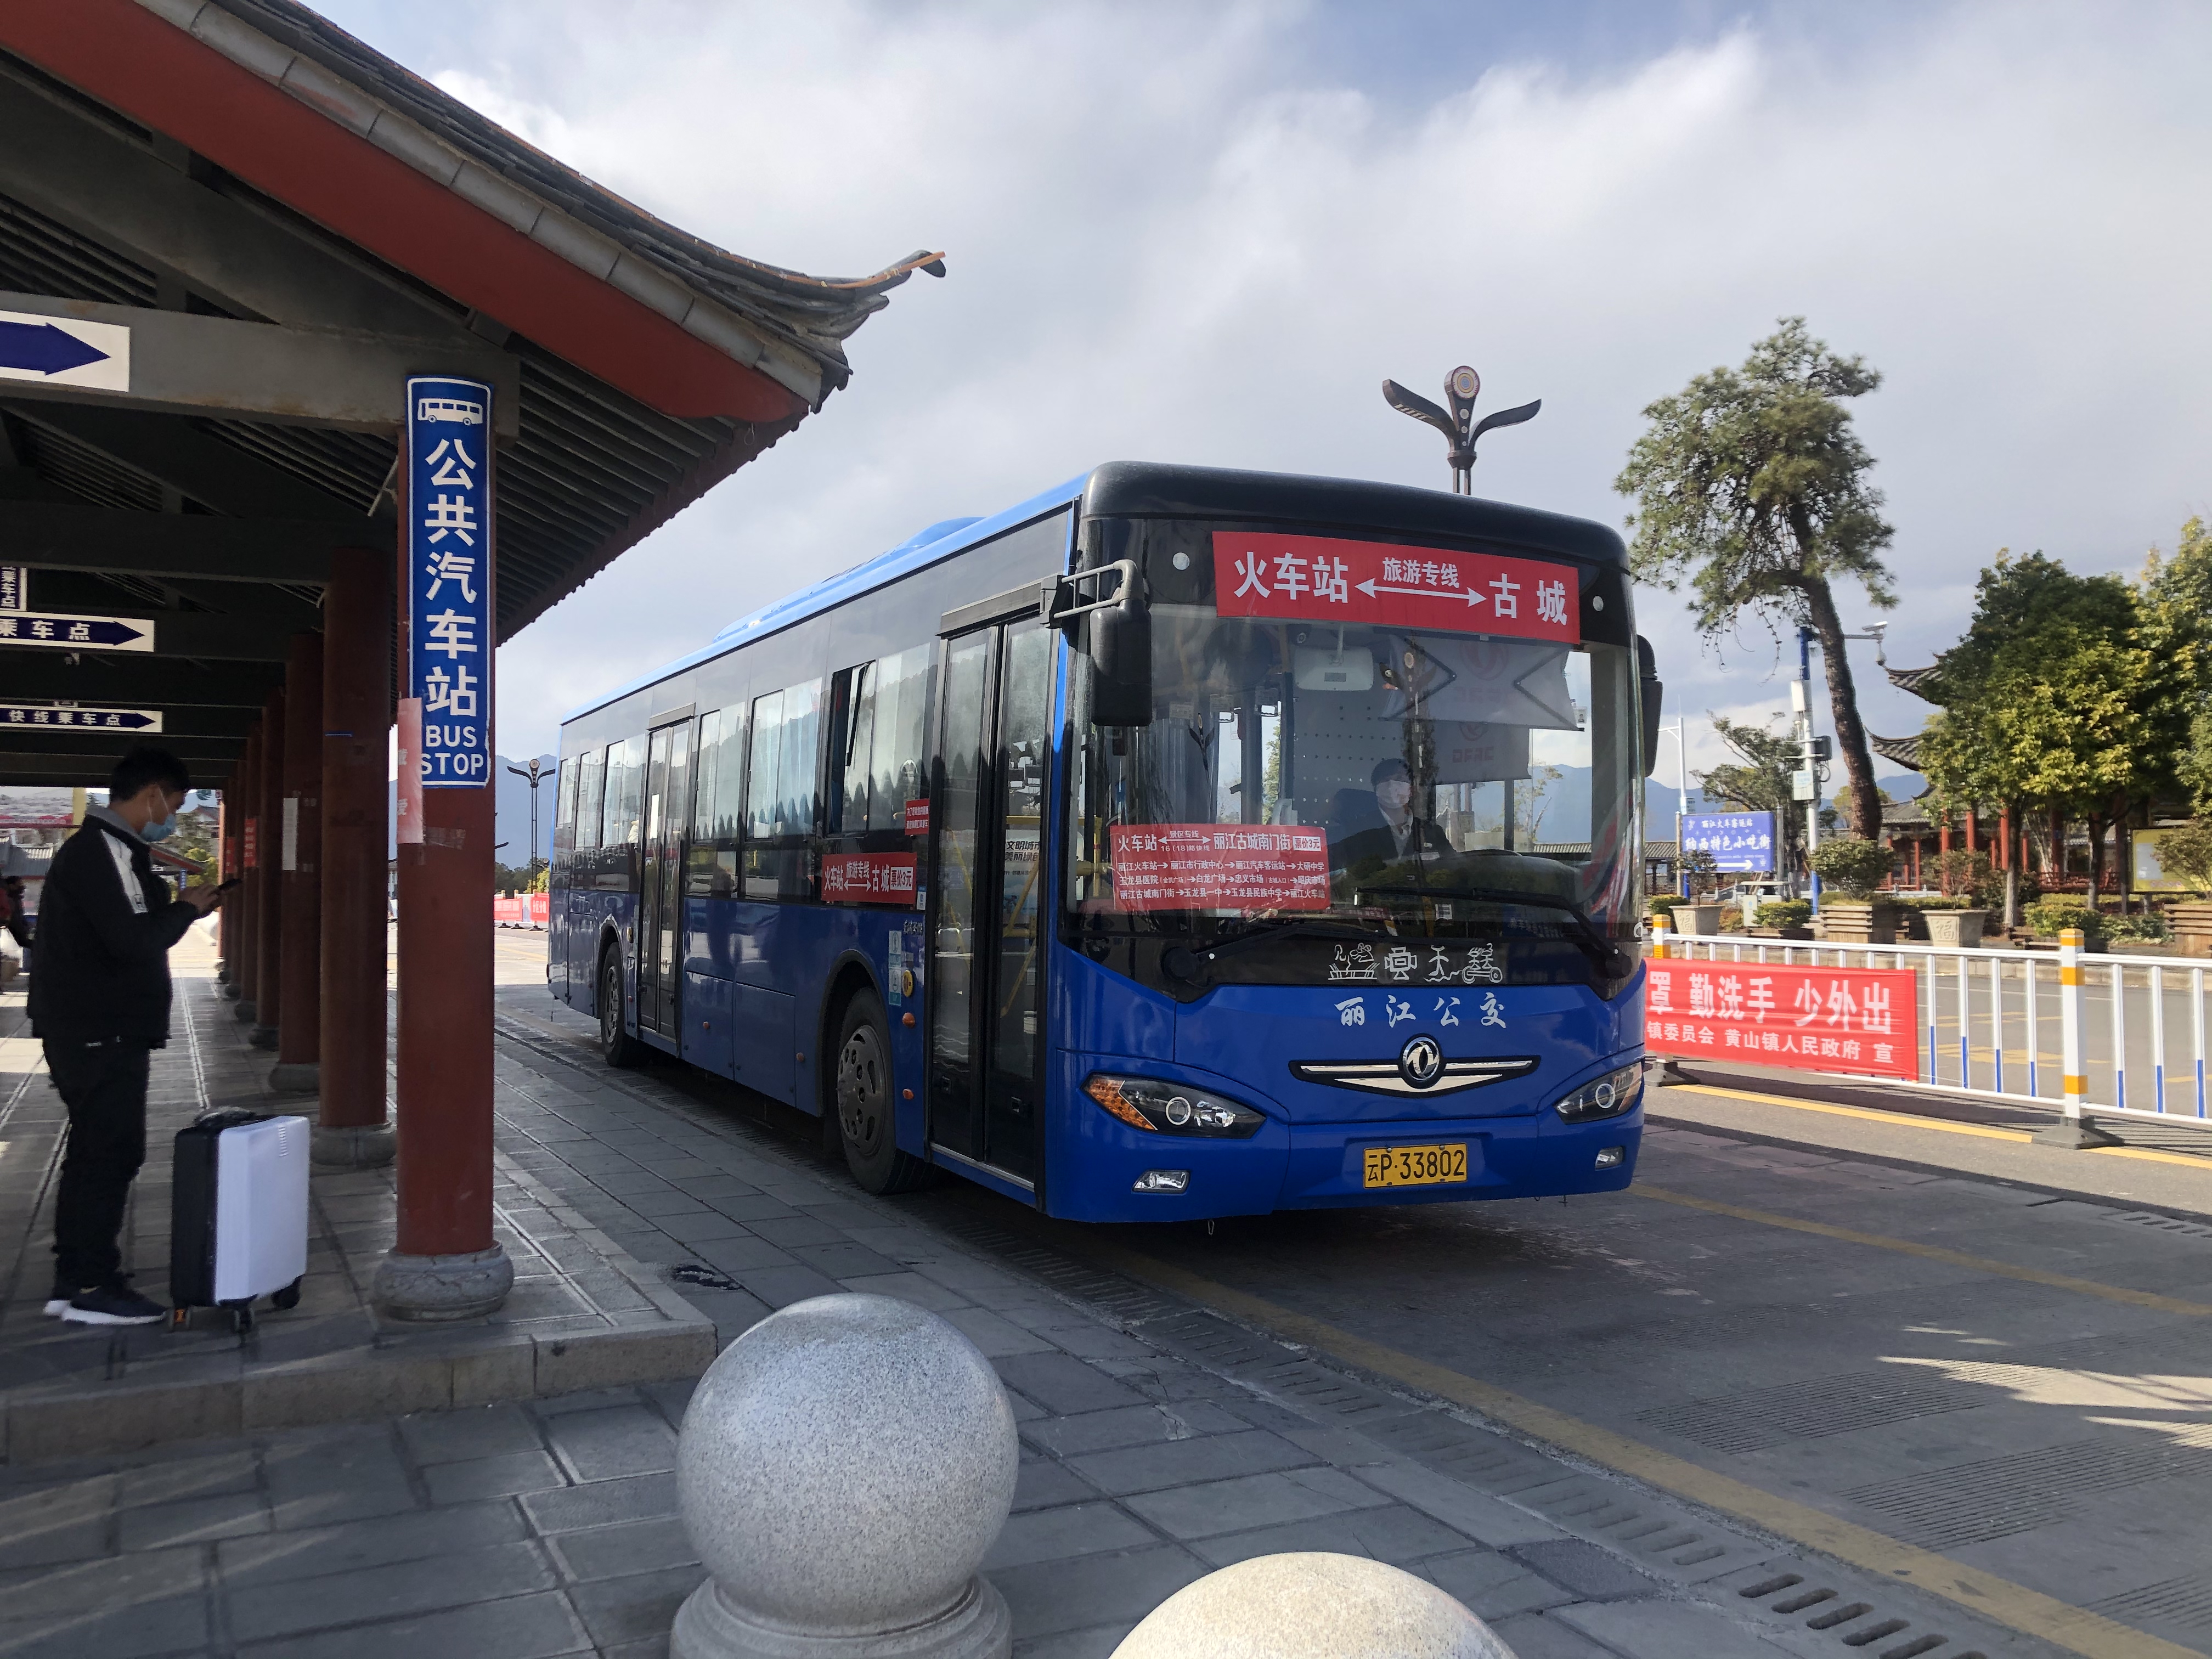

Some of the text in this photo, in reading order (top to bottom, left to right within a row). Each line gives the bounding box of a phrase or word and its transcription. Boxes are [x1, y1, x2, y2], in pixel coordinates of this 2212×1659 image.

[425, 438, 477, 716] 公共汽车站
[1382, 557, 1460, 589] 旅游专线
[1, 566, 16, 607] 乘车点
[1234, 551, 1567, 625] 火车站 古城
[9, 710, 121, 726] 快线乘车点
[426, 725, 477, 747] BUS
[421, 753, 483, 775] STOP
[1118, 833, 1321, 853] 火车站 丽江古城南门街 票价3元
[1170, 830, 1199, 838] 景区专线
[1685, 834, 1771, 851] 纳西特色小吃街
[846, 861, 870, 879] 旅游专线
[1118, 860, 1324, 872] 丽江火车站 丽江市行政中心 丽江汽车客运站 大研中学
[824, 864, 912, 893] 火车站 古城 票价3元
[1120, 874, 1159, 885] 玉龙县医院
[1196, 873, 1226, 883] 白龙广场
[1235, 873, 1263, 884] 忠义市场
[1297, 875, 1325, 885] 昭庆市场
[1120, 888, 1325, 899] 丽江古城南门街 玉龙县一中 玉龙县民族中学 丽江火车站
[1679, 914, 1692, 930] 福
[1936, 920, 1954, 940] 福
[1334, 992, 1506, 1029] 丽江公交
[1649, 971, 1892, 1035] 罩 勤洗手 少外出
[1647, 1020, 1894, 1064] 镇委员会 黄山镇人民政府 宣
